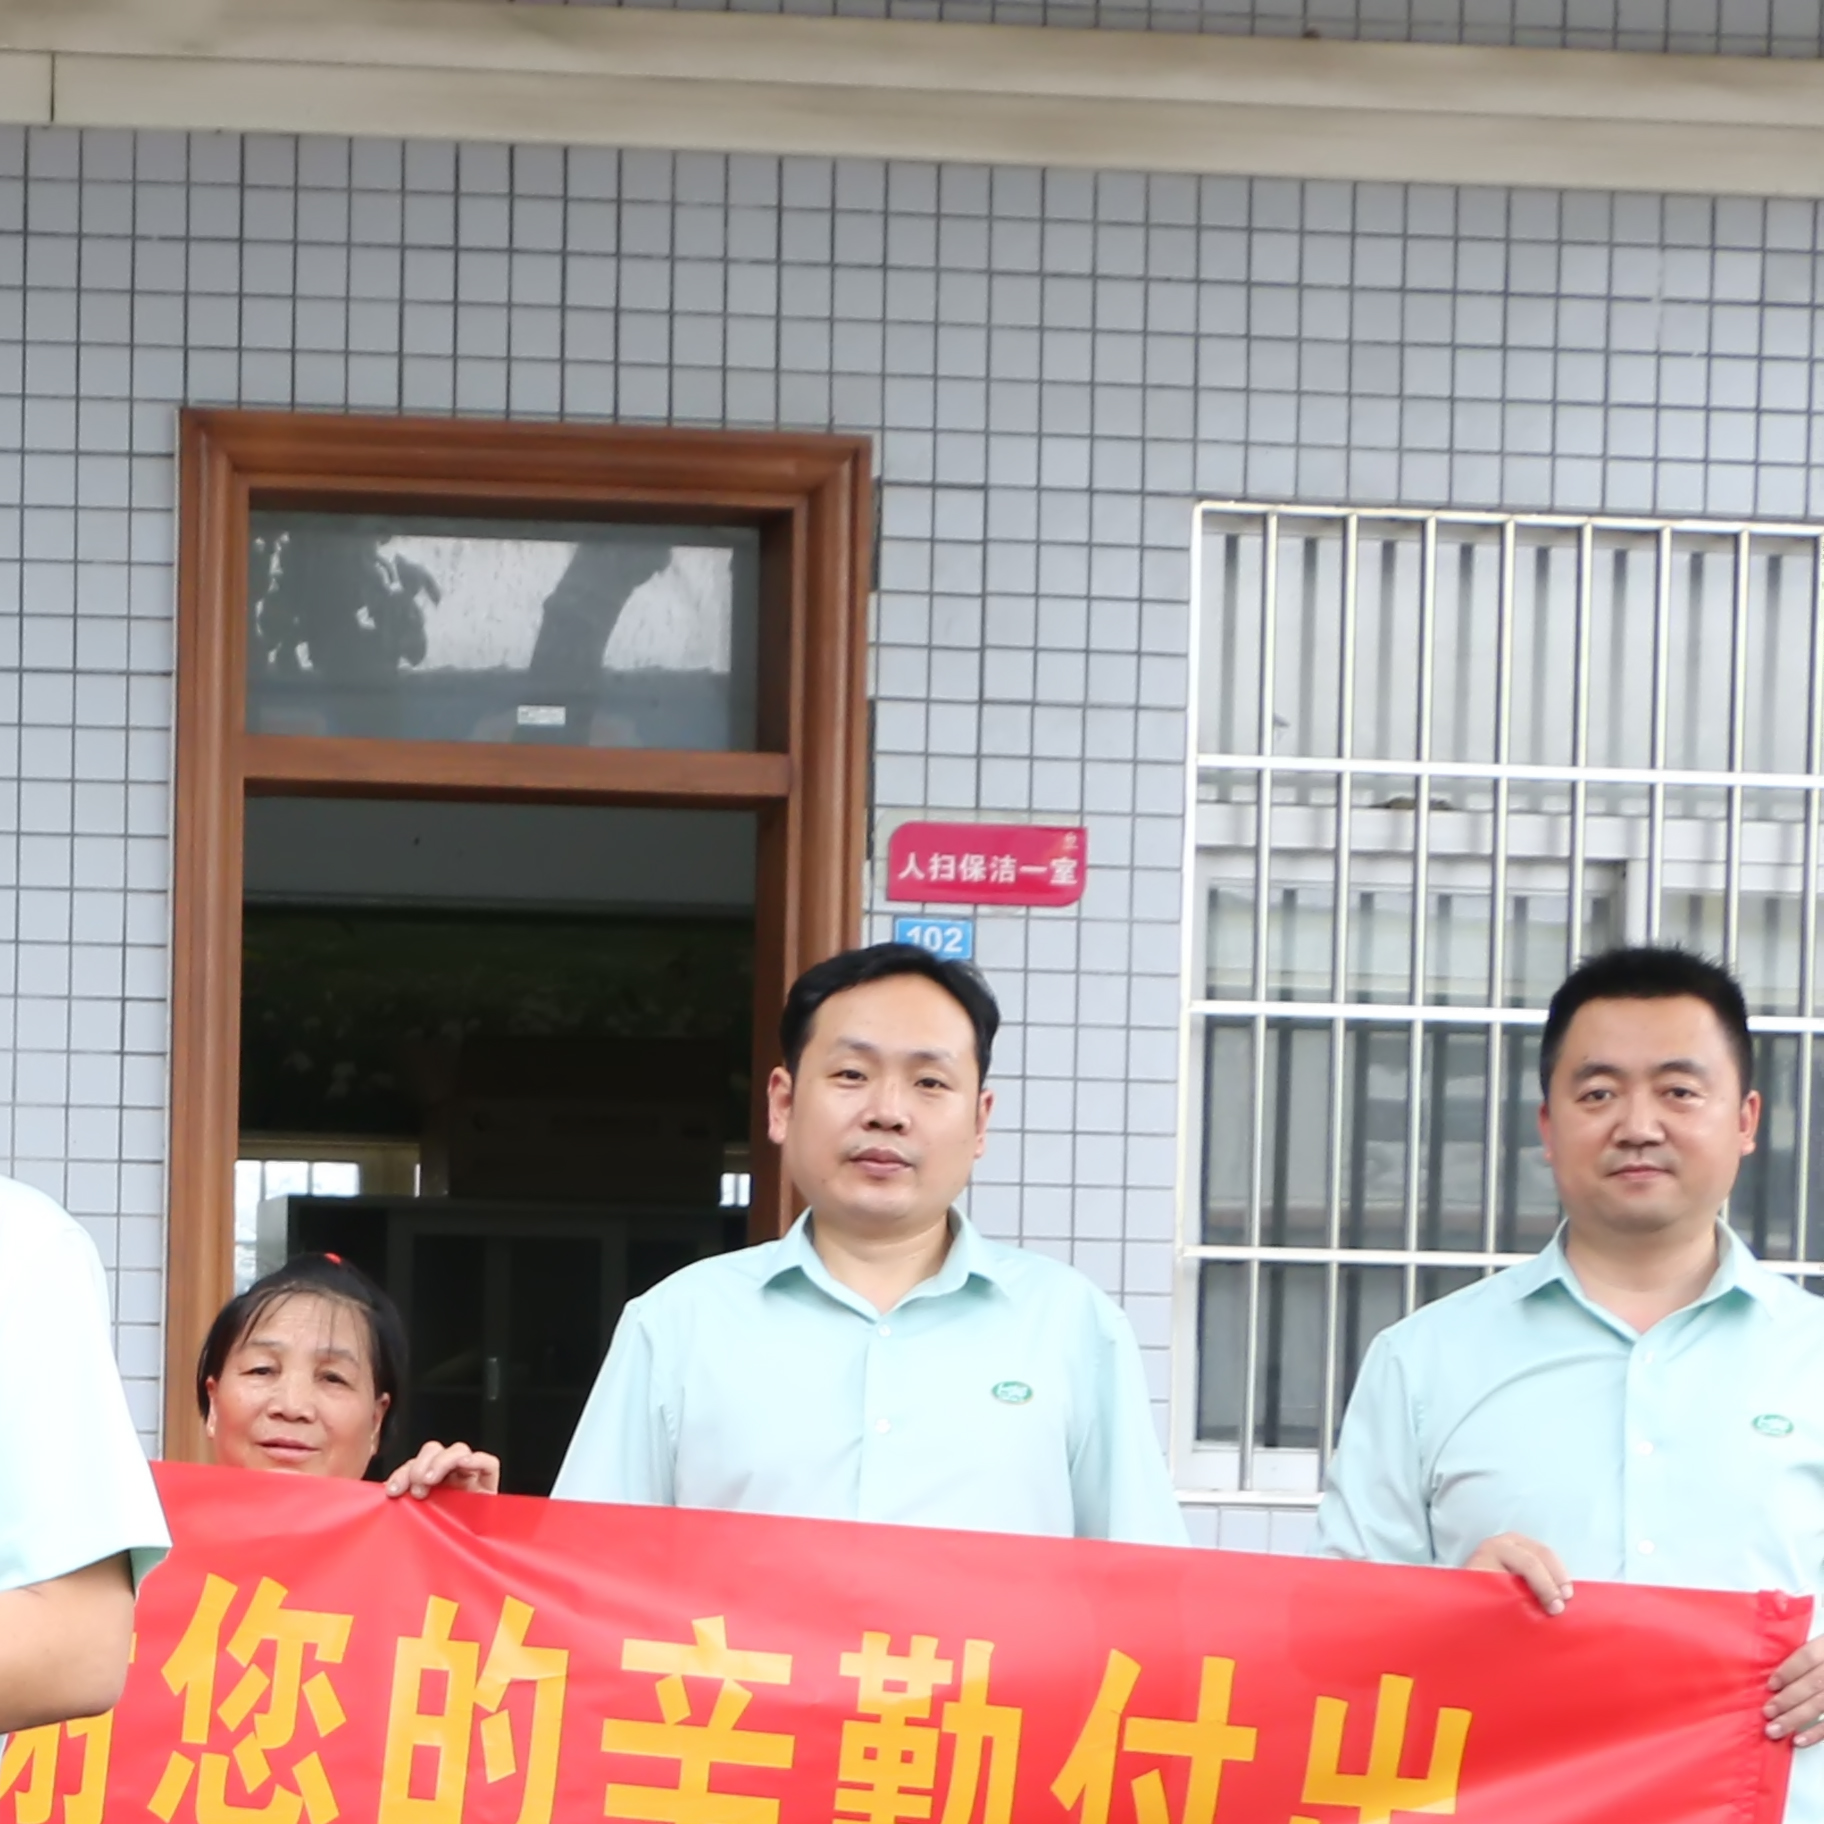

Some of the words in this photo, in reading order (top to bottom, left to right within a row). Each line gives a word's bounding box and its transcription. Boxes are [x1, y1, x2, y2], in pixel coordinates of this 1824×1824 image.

[898, 852, 1078, 886] 人扫保洁一室
[907, 926, 963, 953] 102
